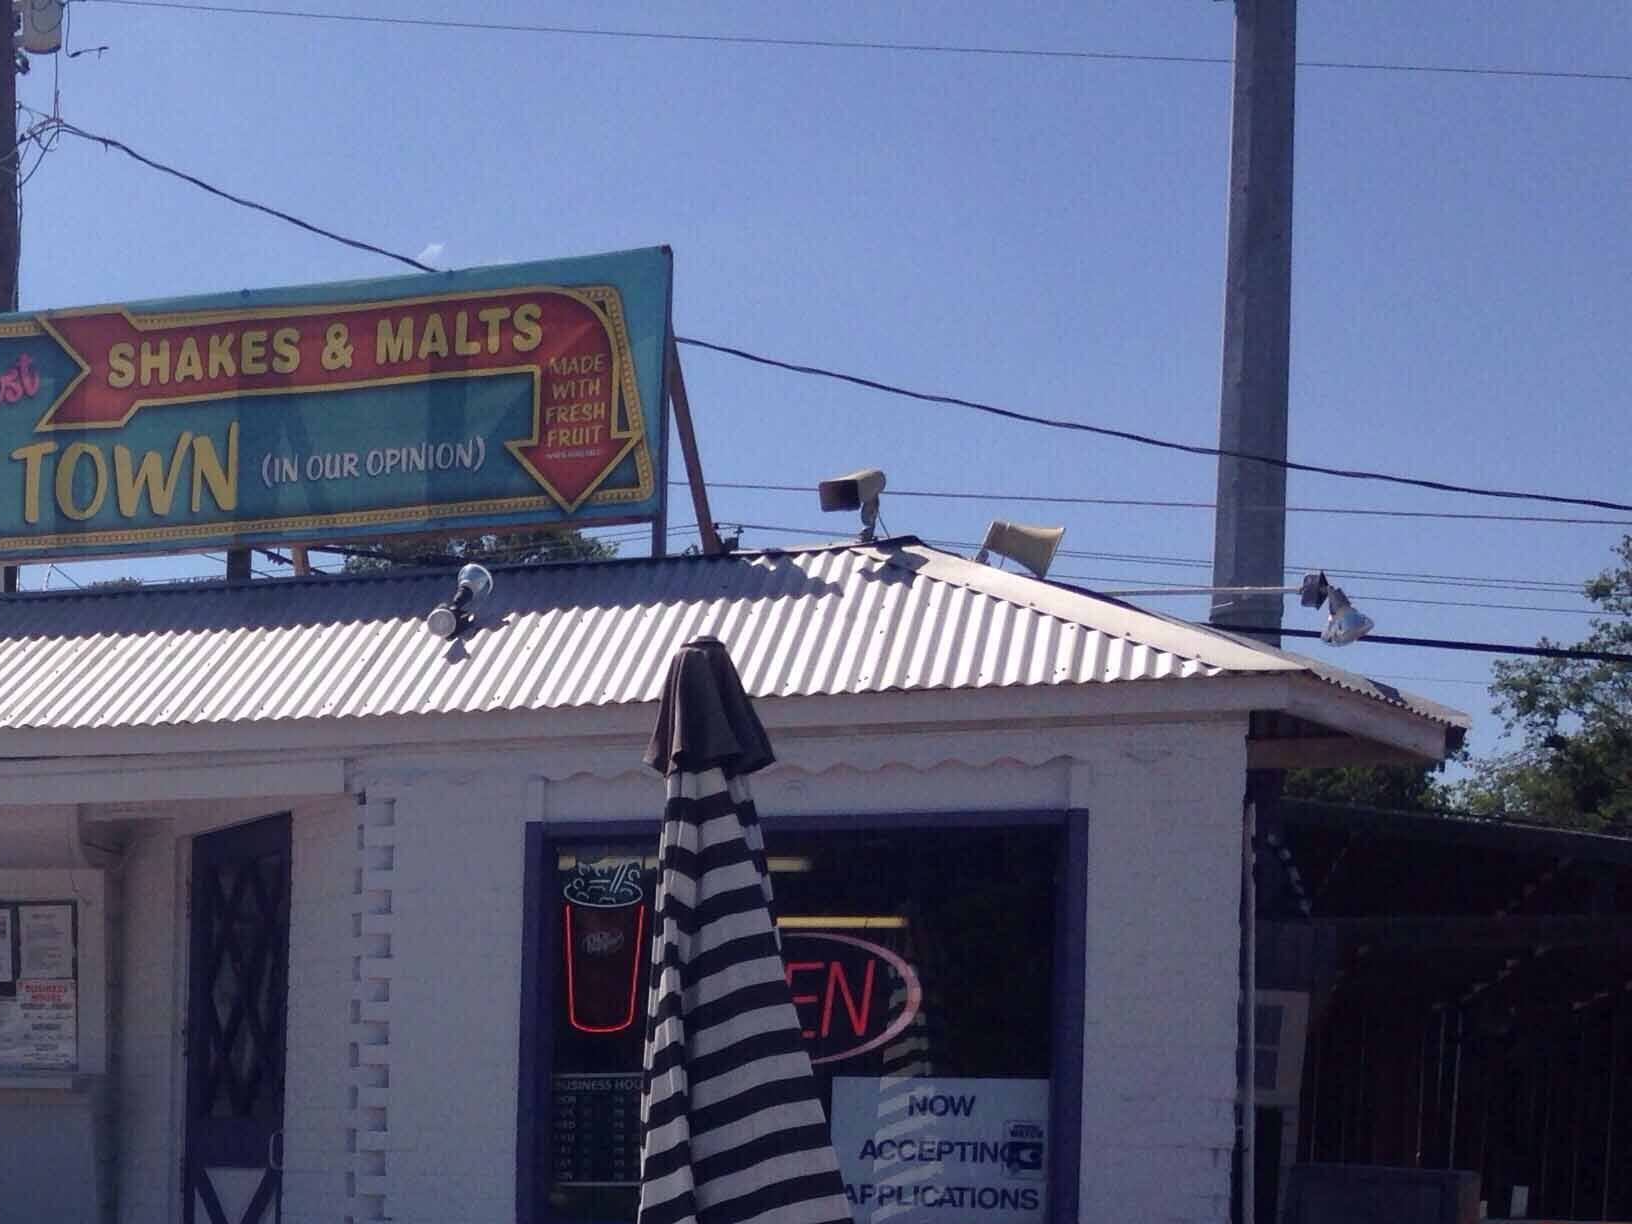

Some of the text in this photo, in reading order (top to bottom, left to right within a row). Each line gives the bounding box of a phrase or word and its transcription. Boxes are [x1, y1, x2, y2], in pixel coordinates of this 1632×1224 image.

[107, 302, 544, 390] SHAKES & MALTS
[550, 353, 608, 376] MADE
[552, 378, 601, 400] WITH
[545, 401, 606, 425] FRESH
[547, 425, 604, 448] FRUIT
[10, 419, 240, 524] TOWN
[261, 434, 487, 488] (IN OUR OPINION)
[784, 958, 876, 1039] EN
[908, 1094, 976, 1118] NOW
[843, 1183, 1040, 1212] APPLICATIONS
